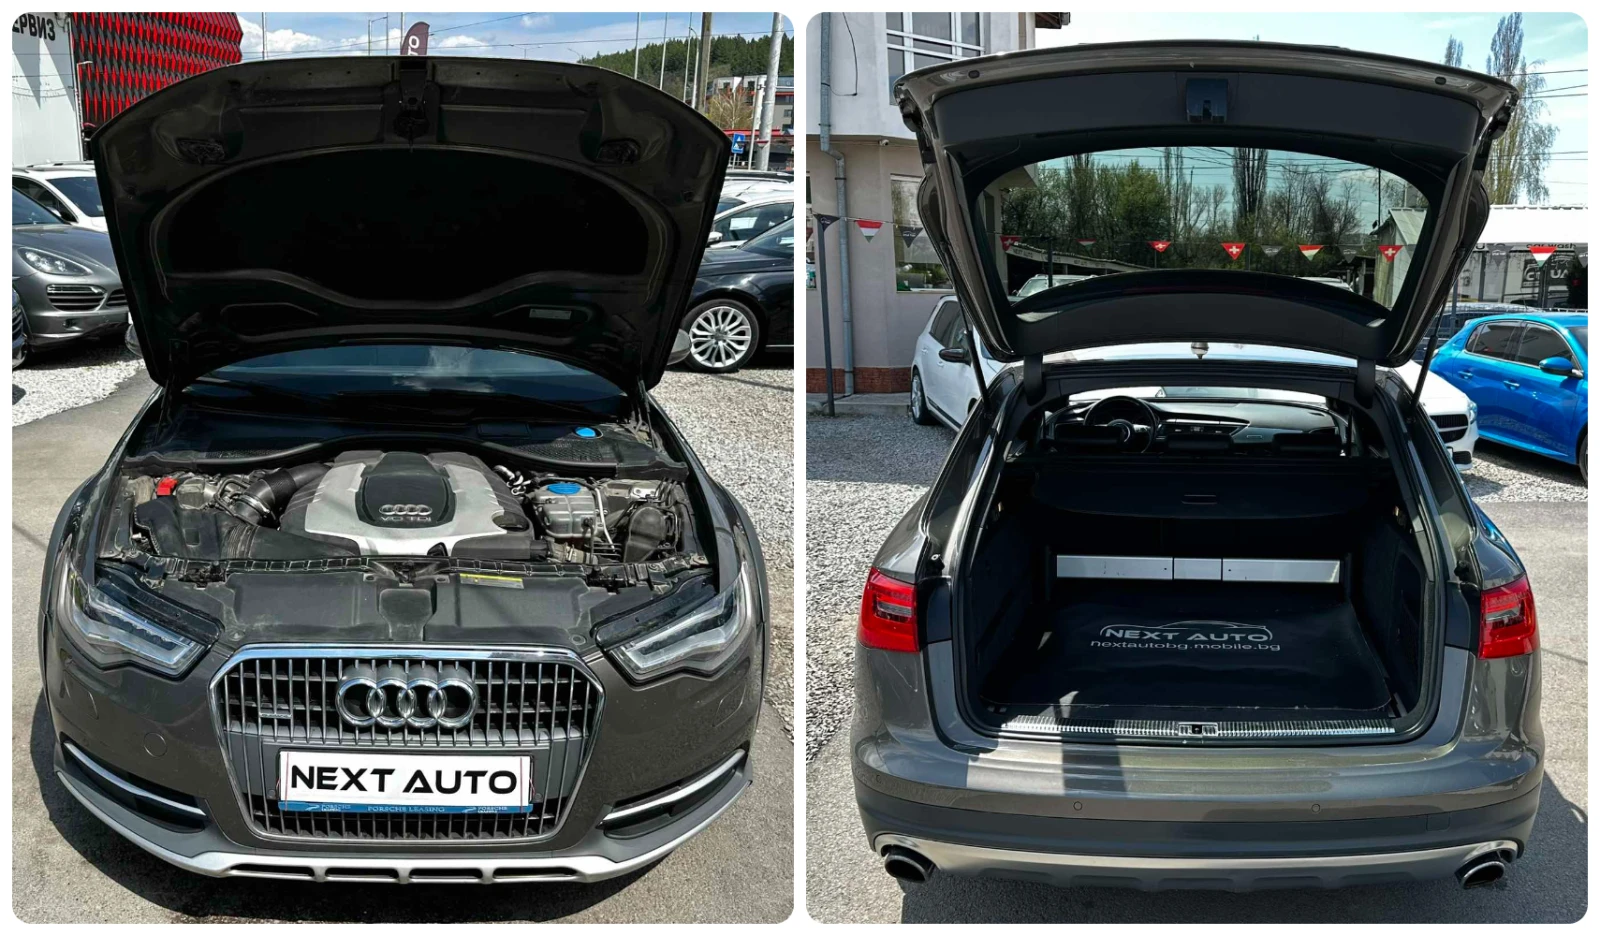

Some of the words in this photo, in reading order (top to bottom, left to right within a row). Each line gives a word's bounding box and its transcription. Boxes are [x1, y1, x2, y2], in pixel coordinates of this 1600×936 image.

[1105, 629, 1179, 640] NEXT
[1187, 633, 1269, 642] AUTO
[1090, 640, 1281, 651] nextautobg.mobile.bg
[291, 764, 395, 793] NEXT
[402, 769, 517, 795] AUTO
